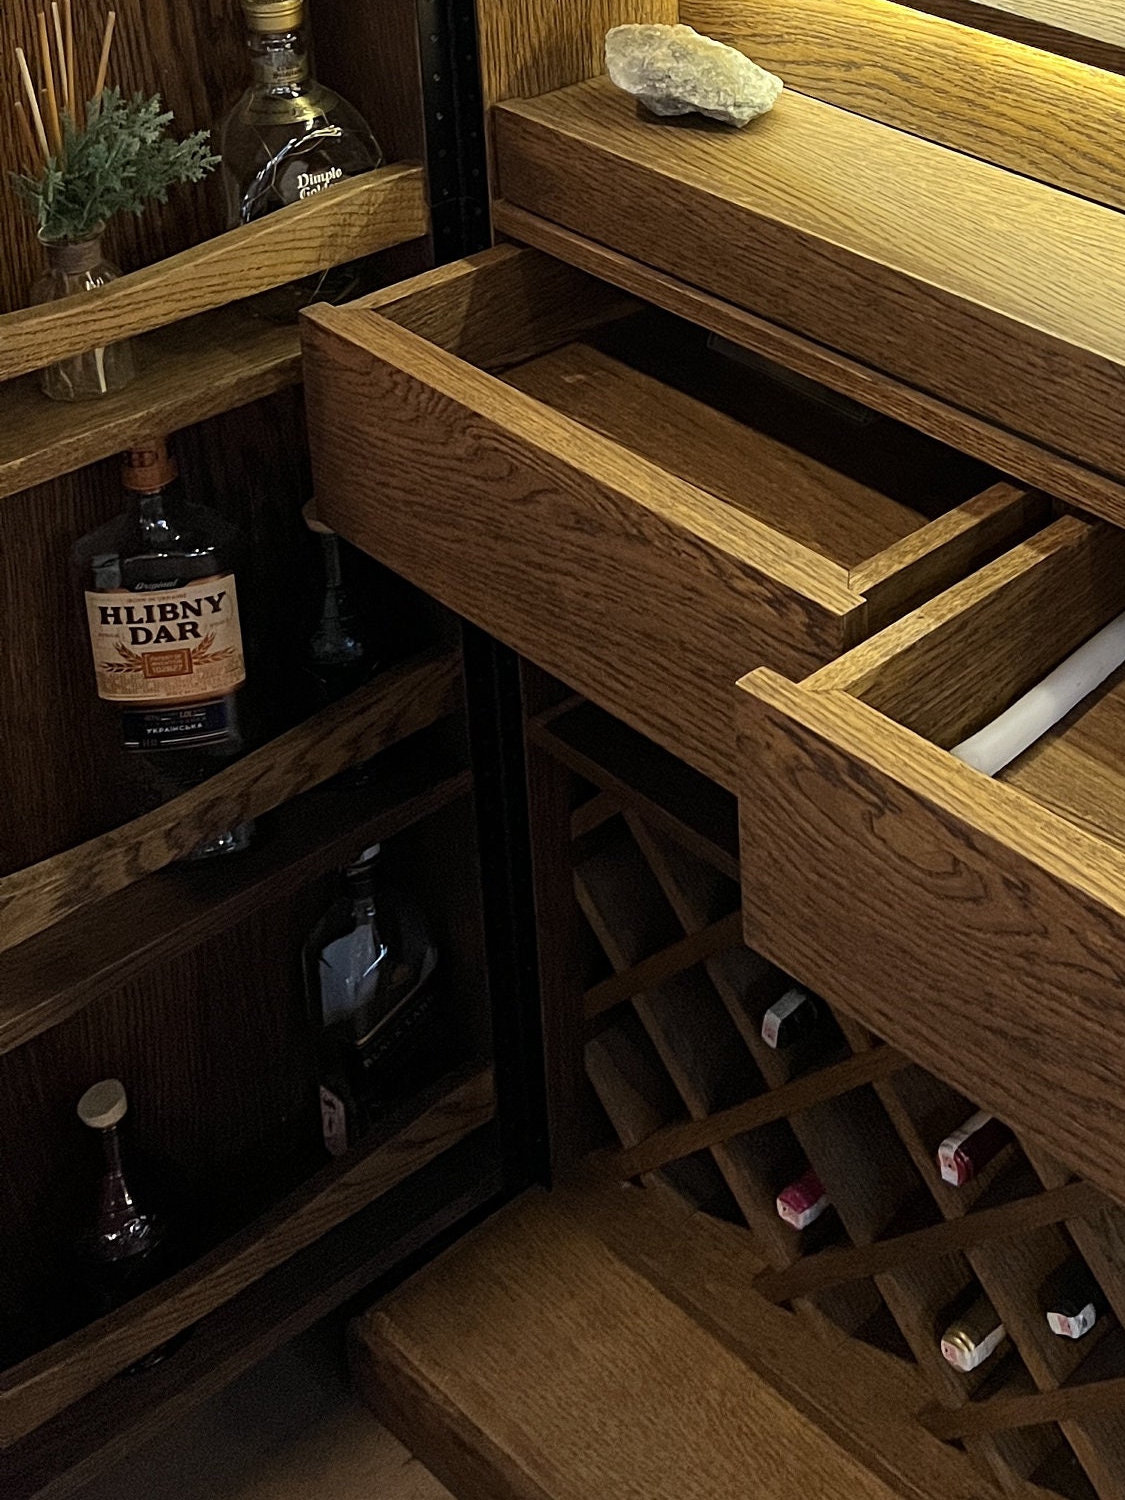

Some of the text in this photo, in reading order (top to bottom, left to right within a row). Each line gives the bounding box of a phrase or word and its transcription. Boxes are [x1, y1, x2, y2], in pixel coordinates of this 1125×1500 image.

[297, 167, 342, 190] Dimple
[99, 591, 226, 625] HLIBNY
[129, 621, 202, 646] DAR
